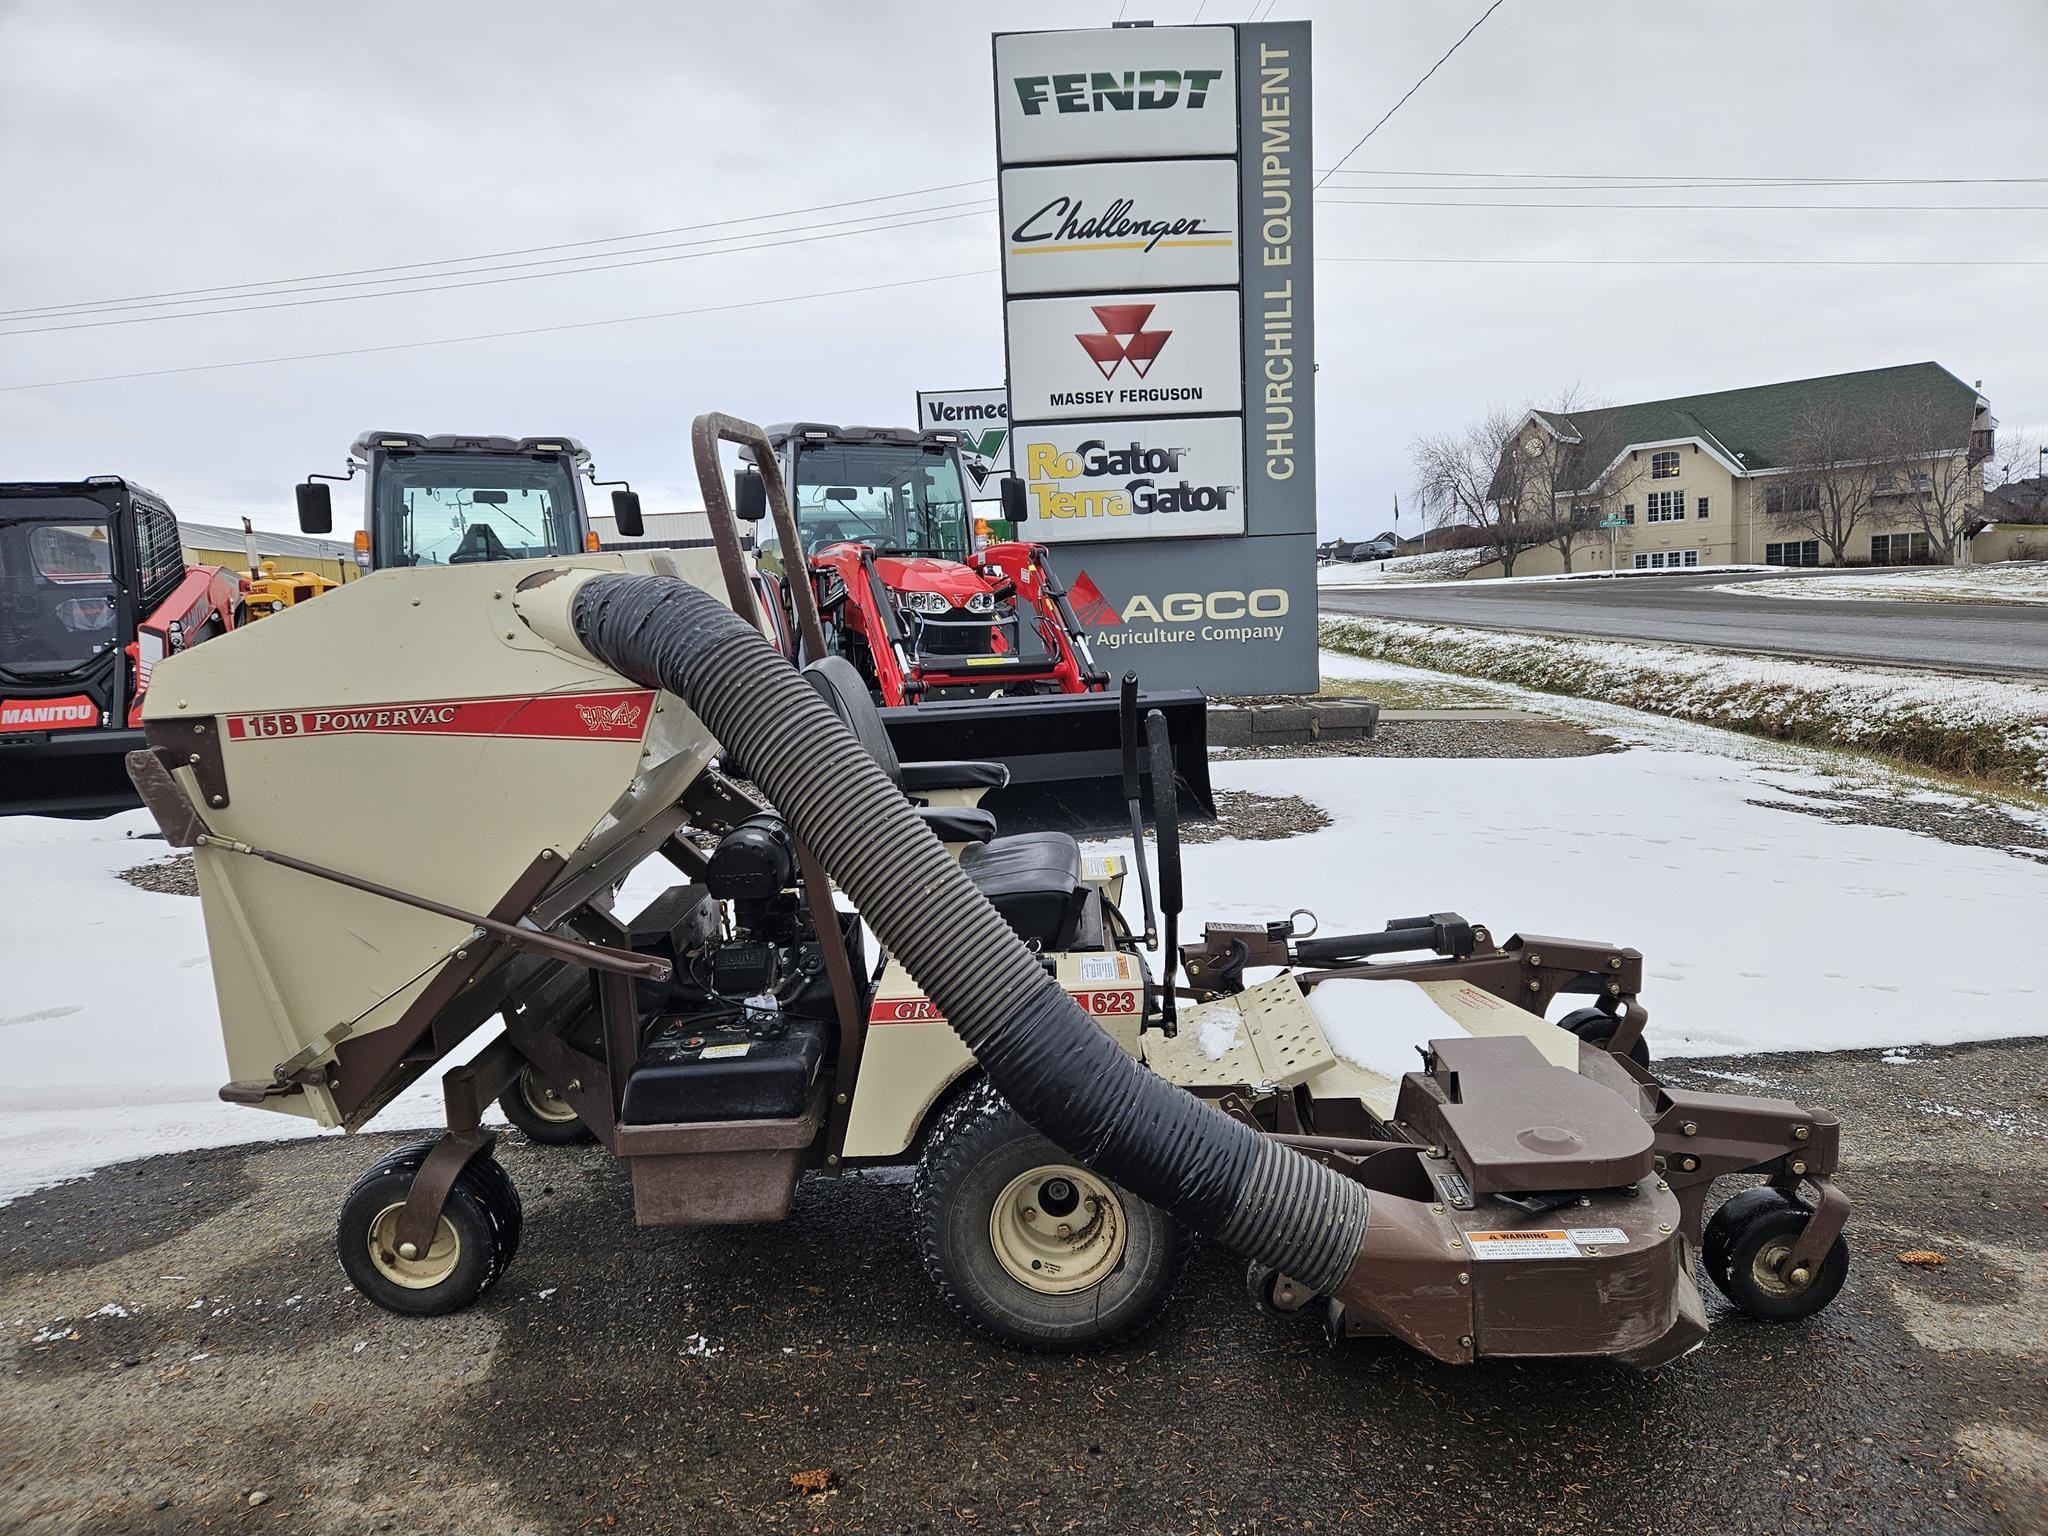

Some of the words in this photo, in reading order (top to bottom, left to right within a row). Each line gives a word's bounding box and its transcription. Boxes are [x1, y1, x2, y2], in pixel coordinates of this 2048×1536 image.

[1013, 70, 1223, 116] FENDT
[1260, 42, 1292, 266] EQUIPMENT
[1011, 196, 1232, 253] Challenger
[1264, 279, 1295, 480] CHURCHILL
[928, 401, 1007, 421] Vermee
[1050, 390, 1114, 406] MASSEY
[1120, 387, 1203, 402] FERGUSON
[1027, 440, 1187, 480] RoGator
[1029, 479, 1235, 519] TerraGator
[1121, 589, 1289, 624] AGCO
[1096, 628, 1196, 649] Agriculture
[1201, 626, 1284, 643] Company
[1, 705, 91, 725] MANITOU
[249, 715, 298, 736] 15B
[1092, 991, 1136, 1014] 623
[1500, 1232, 1549, 1240] WARNING
